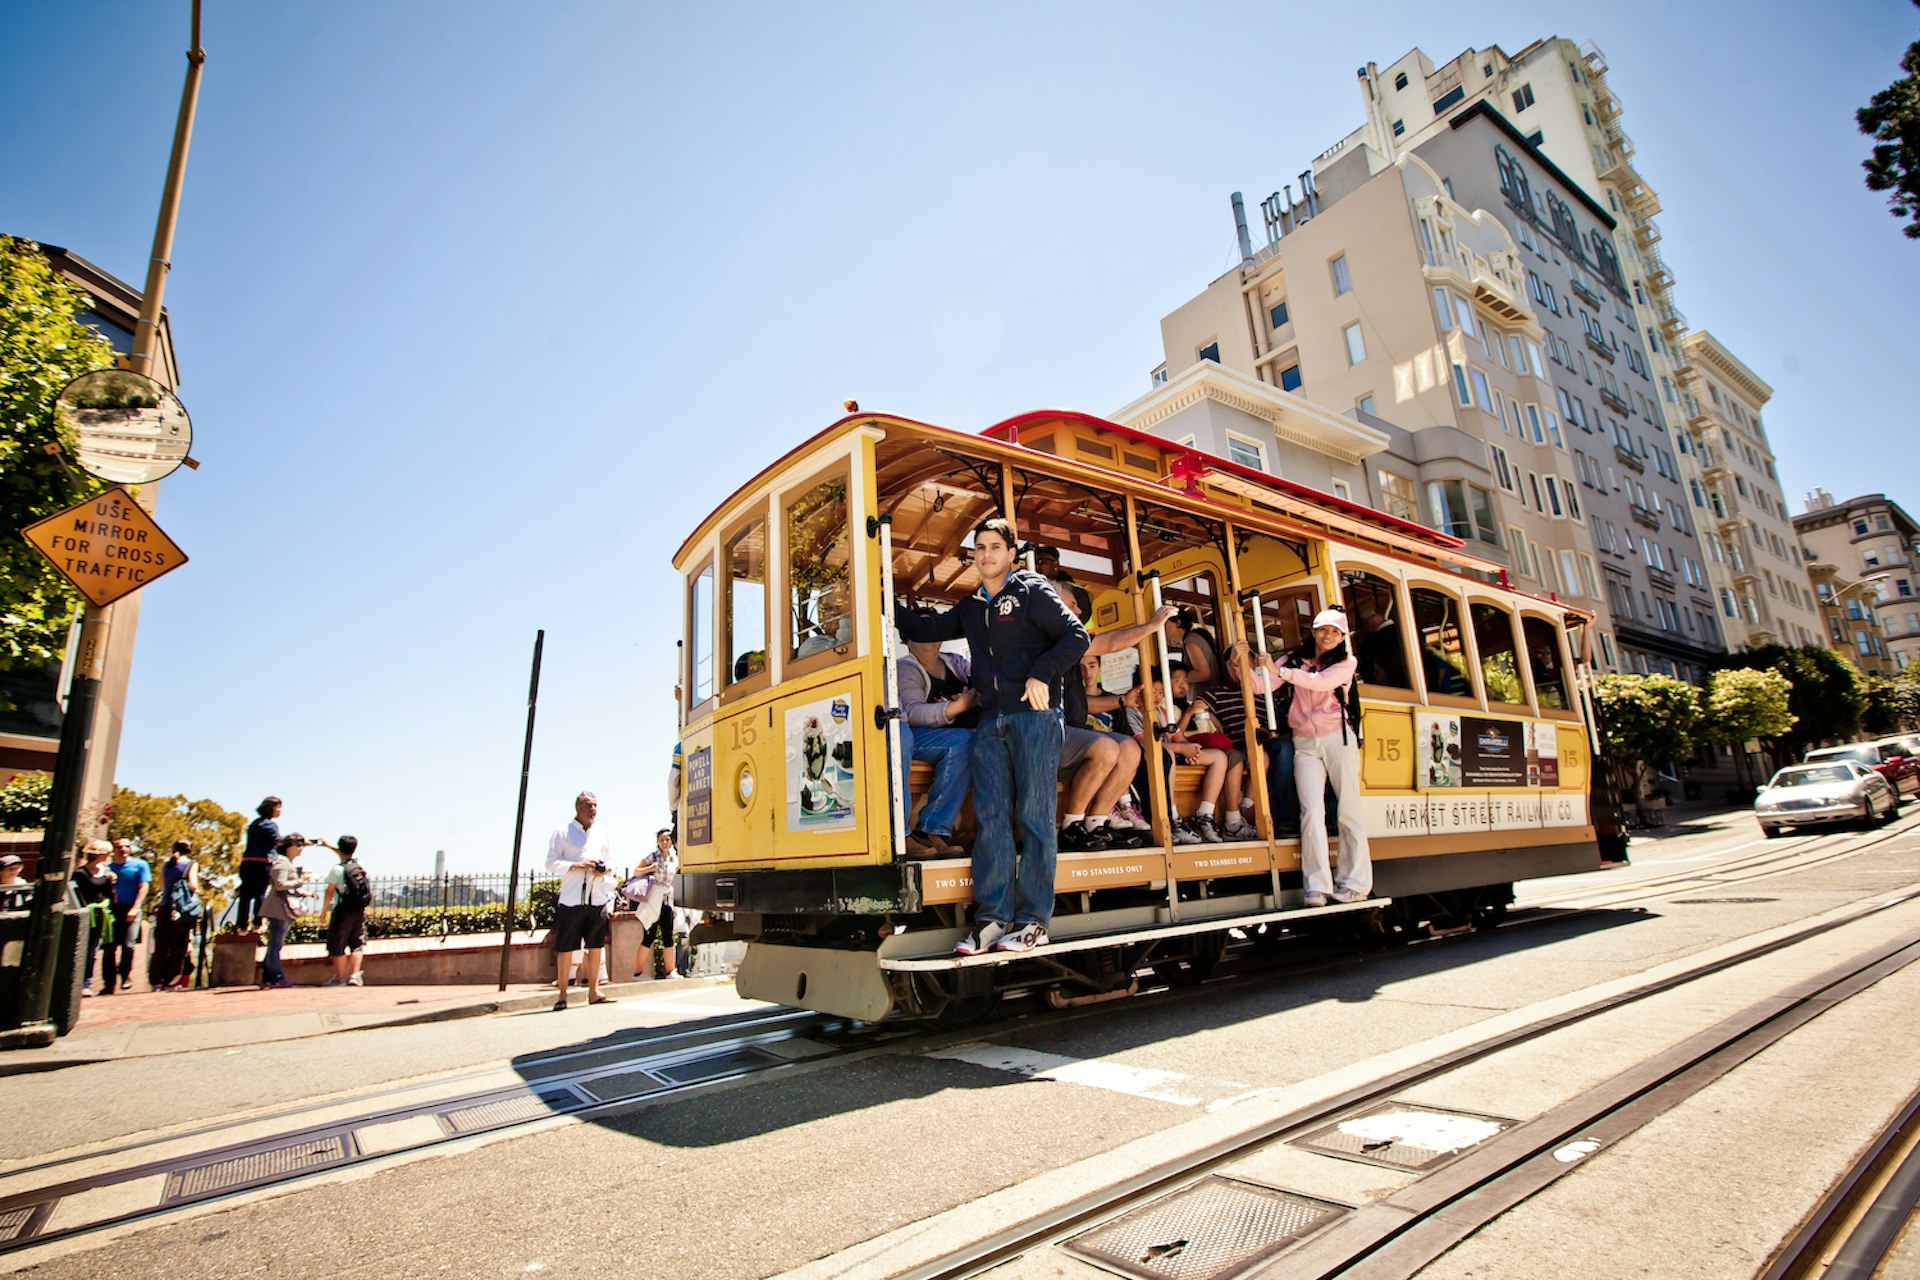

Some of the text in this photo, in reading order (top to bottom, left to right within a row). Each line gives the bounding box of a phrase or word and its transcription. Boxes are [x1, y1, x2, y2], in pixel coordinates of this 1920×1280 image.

[95, 502, 133, 521] USE
[74, 518, 148, 543] MIRROR
[51, 535, 165, 566] FOR CROSS
[65, 557, 145, 582] TRAFFIC
[999, 600, 1013, 616] 19
[731, 714, 757, 751] 15
[1376, 738, 1401, 762] 15
[1562, 749, 1578, 769] 15
[689, 754, 710, 773] POWELL
[694, 767, 705, 779] AND
[688, 776, 710, 793] MARKET
[1385, 803, 1446, 830] MARKET
[1452, 802, 1502, 825] STREET
[1507, 801, 1553, 823] RAILWAY
[1071, 863, 1144, 877] TWO STANDEES ONLY
[1194, 856, 1253, 869] TWO STANDEES ONLY
[935, 879, 957, 889] TWO
